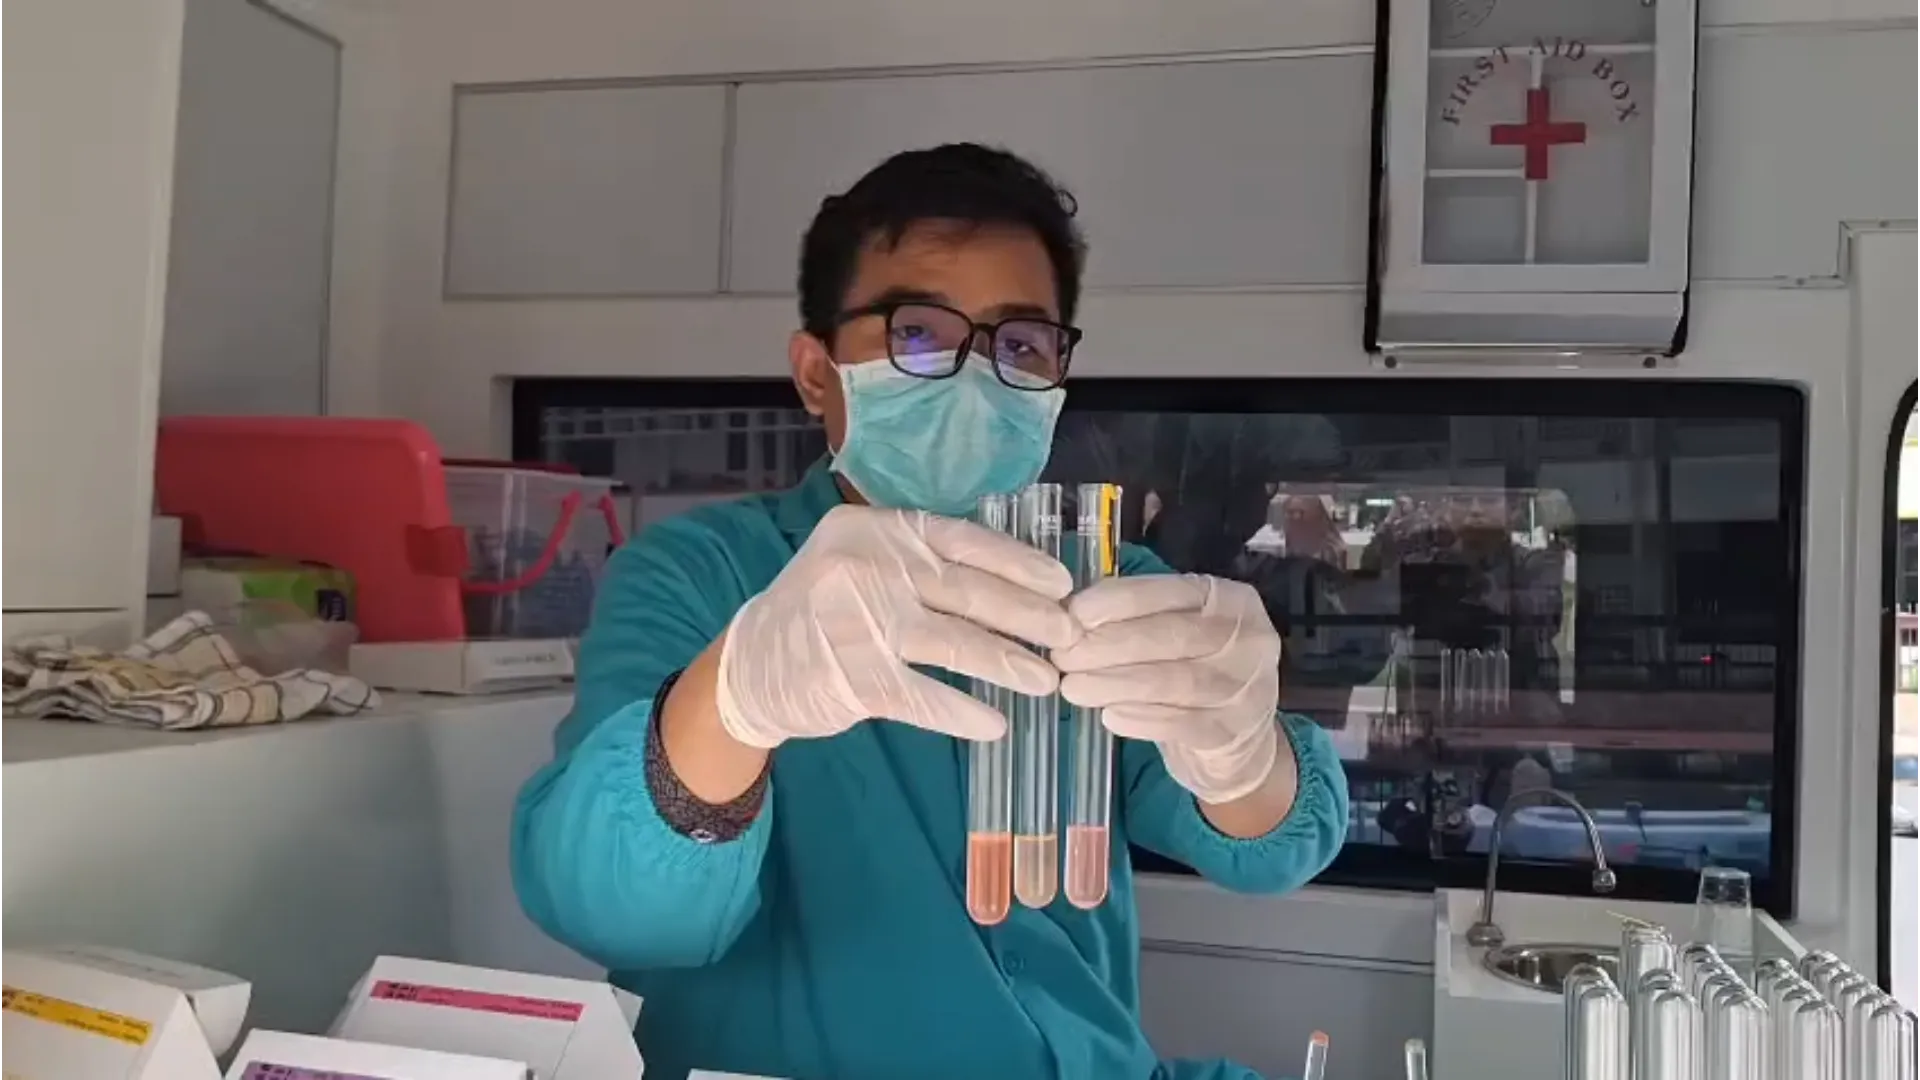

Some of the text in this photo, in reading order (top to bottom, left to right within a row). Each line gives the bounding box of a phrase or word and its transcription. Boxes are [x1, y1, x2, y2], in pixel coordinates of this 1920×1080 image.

[1442, 36, 1640, 125] FIRST AID BOX
